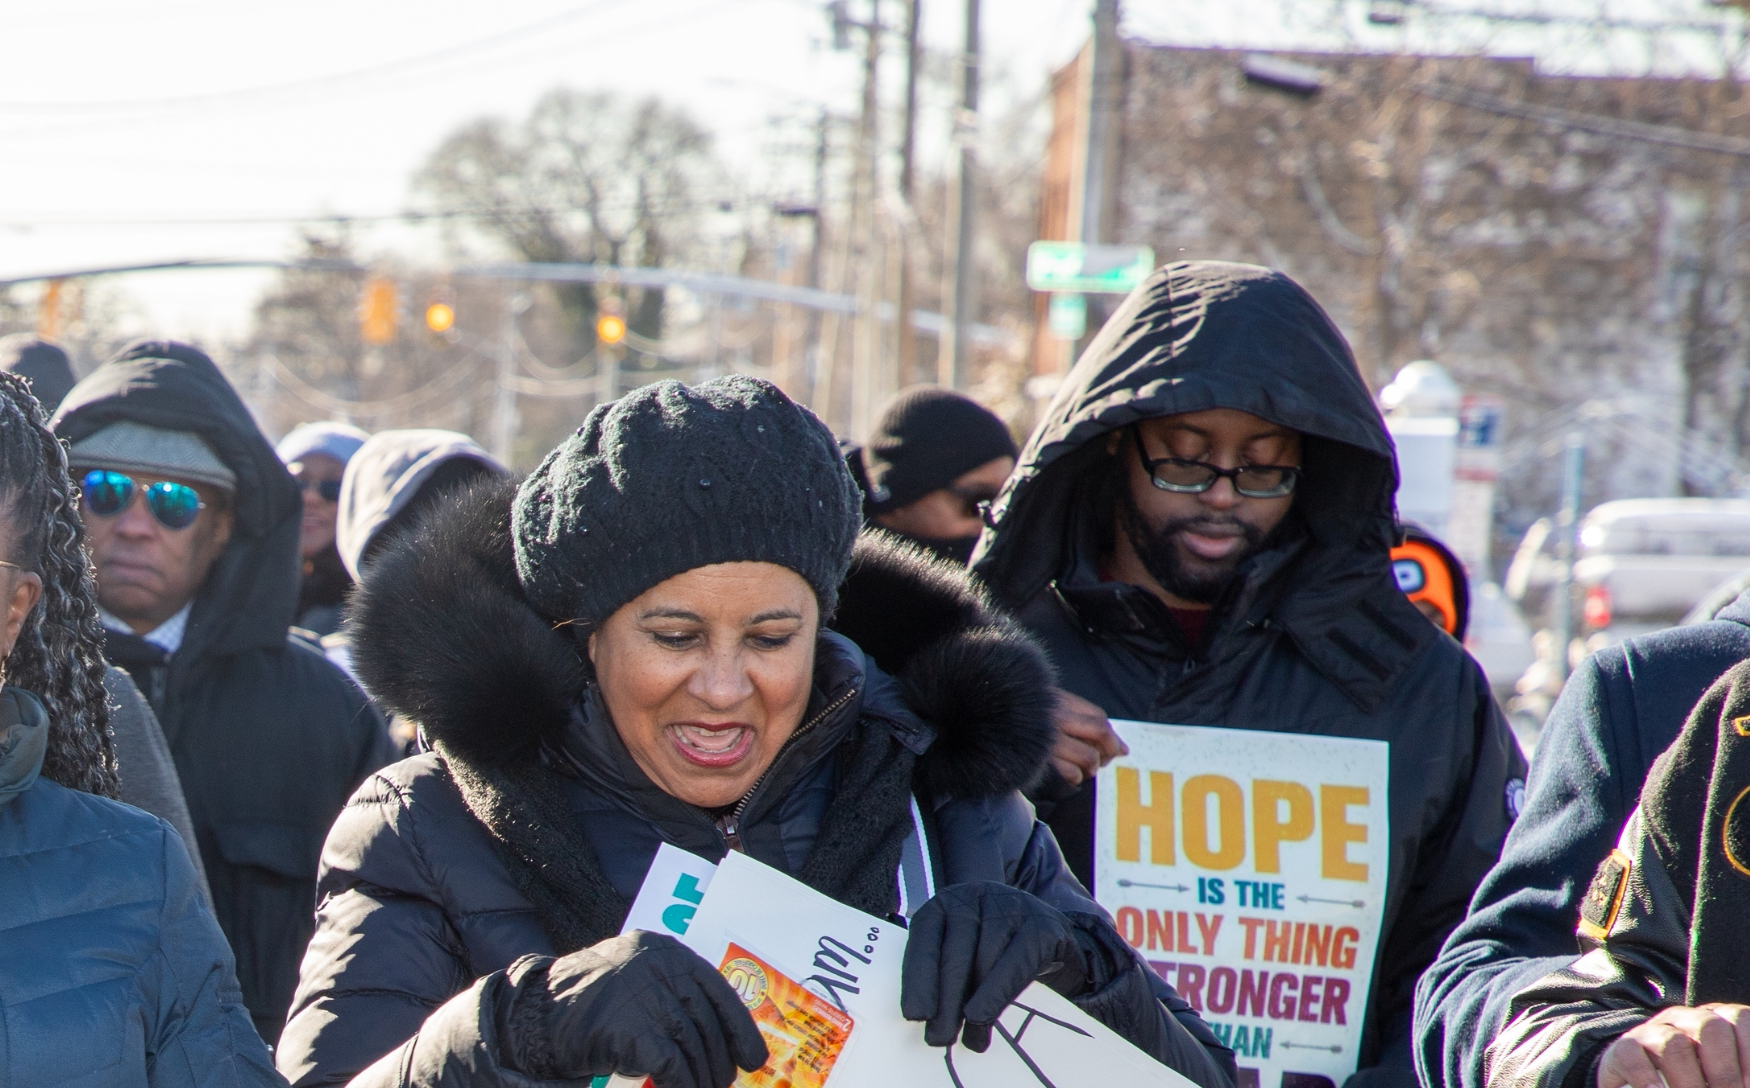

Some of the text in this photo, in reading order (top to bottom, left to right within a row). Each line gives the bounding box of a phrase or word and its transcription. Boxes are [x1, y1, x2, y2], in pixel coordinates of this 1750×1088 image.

[1115, 766, 1370, 883] HOPE
[1197, 876, 1285, 910] IS THE
[1116, 906, 1360, 970] ONLY THING
[1148, 960, 1351, 1026] TRONGER
[842, 1018, 852, 1033] 2
[1207, 1021, 1273, 1059] HAN
